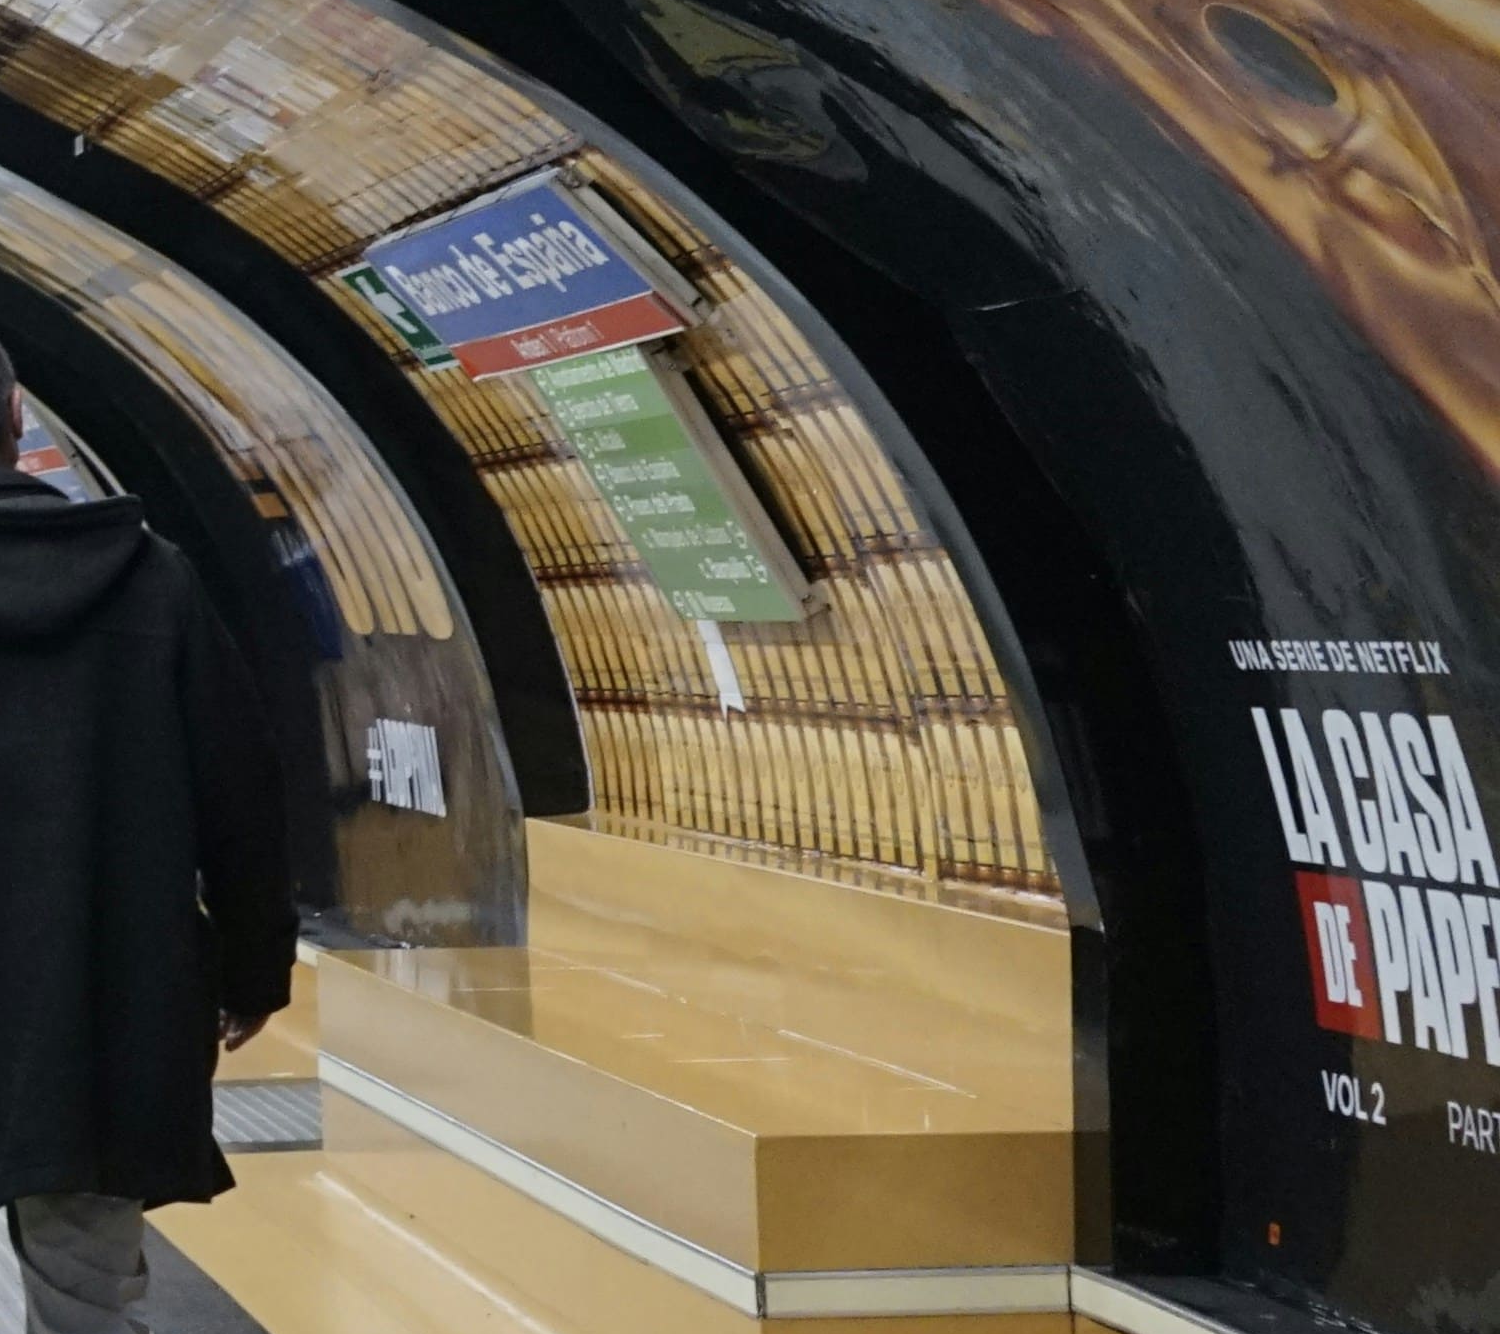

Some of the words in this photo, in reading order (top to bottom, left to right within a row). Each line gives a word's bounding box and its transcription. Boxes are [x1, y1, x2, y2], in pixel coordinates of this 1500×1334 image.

[384, 264, 481, 316] Banco
[449, 243, 513, 300] de
[1228, 639, 1274, 670] UNA
[1270, 640, 1330, 672] SERIE
[1324, 640, 1360, 673] DE
[1354, 641, 1450, 674] NETFLIX
[1251, 706, 1347, 868] LA
[1322, 709, 1500, 889] CASA
[1313, 900, 1364, 1008] DE
[1361, 879, 1500, 1067] PAPE
[1321, 1069, 1369, 1122] VOL
[1370, 1081, 1387, 1126] 2
[1446, 1100, 1500, 1154] PART
